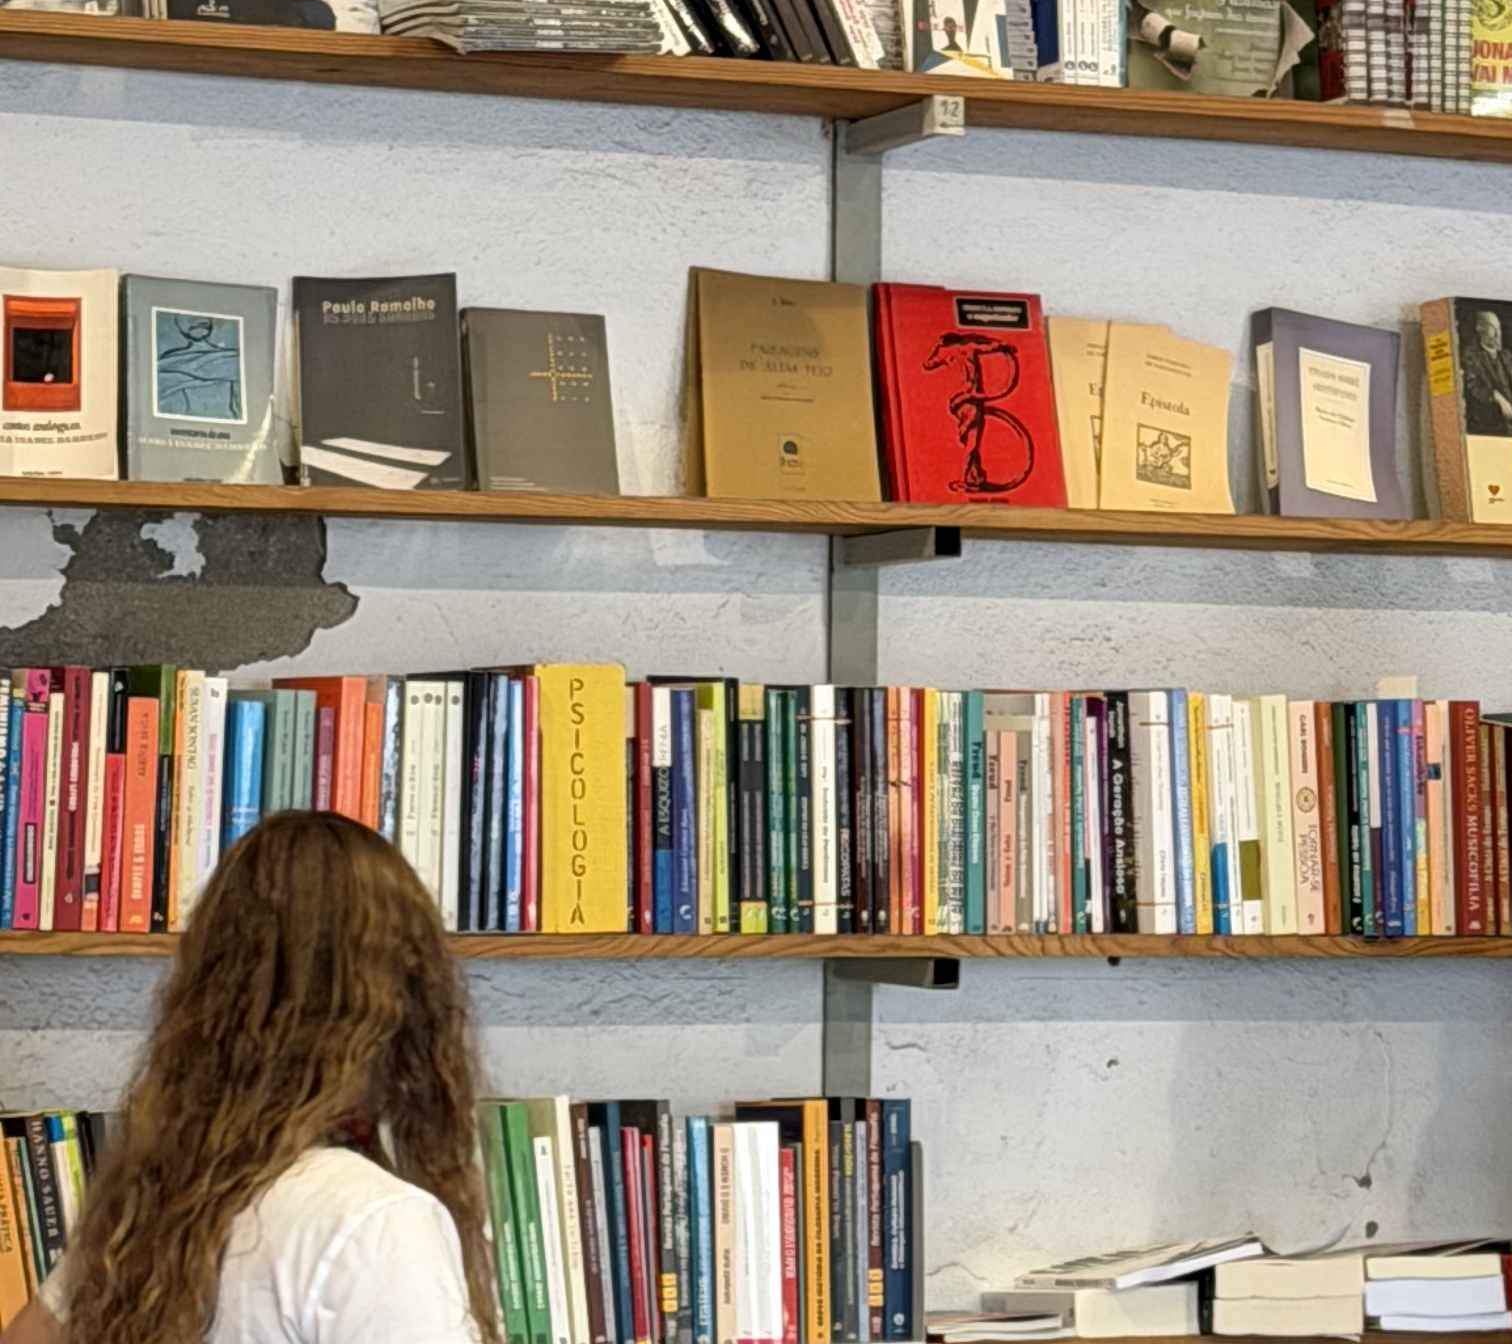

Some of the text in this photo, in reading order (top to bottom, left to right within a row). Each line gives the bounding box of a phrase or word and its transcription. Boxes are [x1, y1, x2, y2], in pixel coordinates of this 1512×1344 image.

[322, 296, 436, 314] Paulo Ramalho
[568, 677, 588, 925] PSICOLOGIA
[1111, 759, 1126, 894] A Geração Ansiosa
[1464, 709, 1480, 911] OLIVER SACKS MUSICOFILIA
